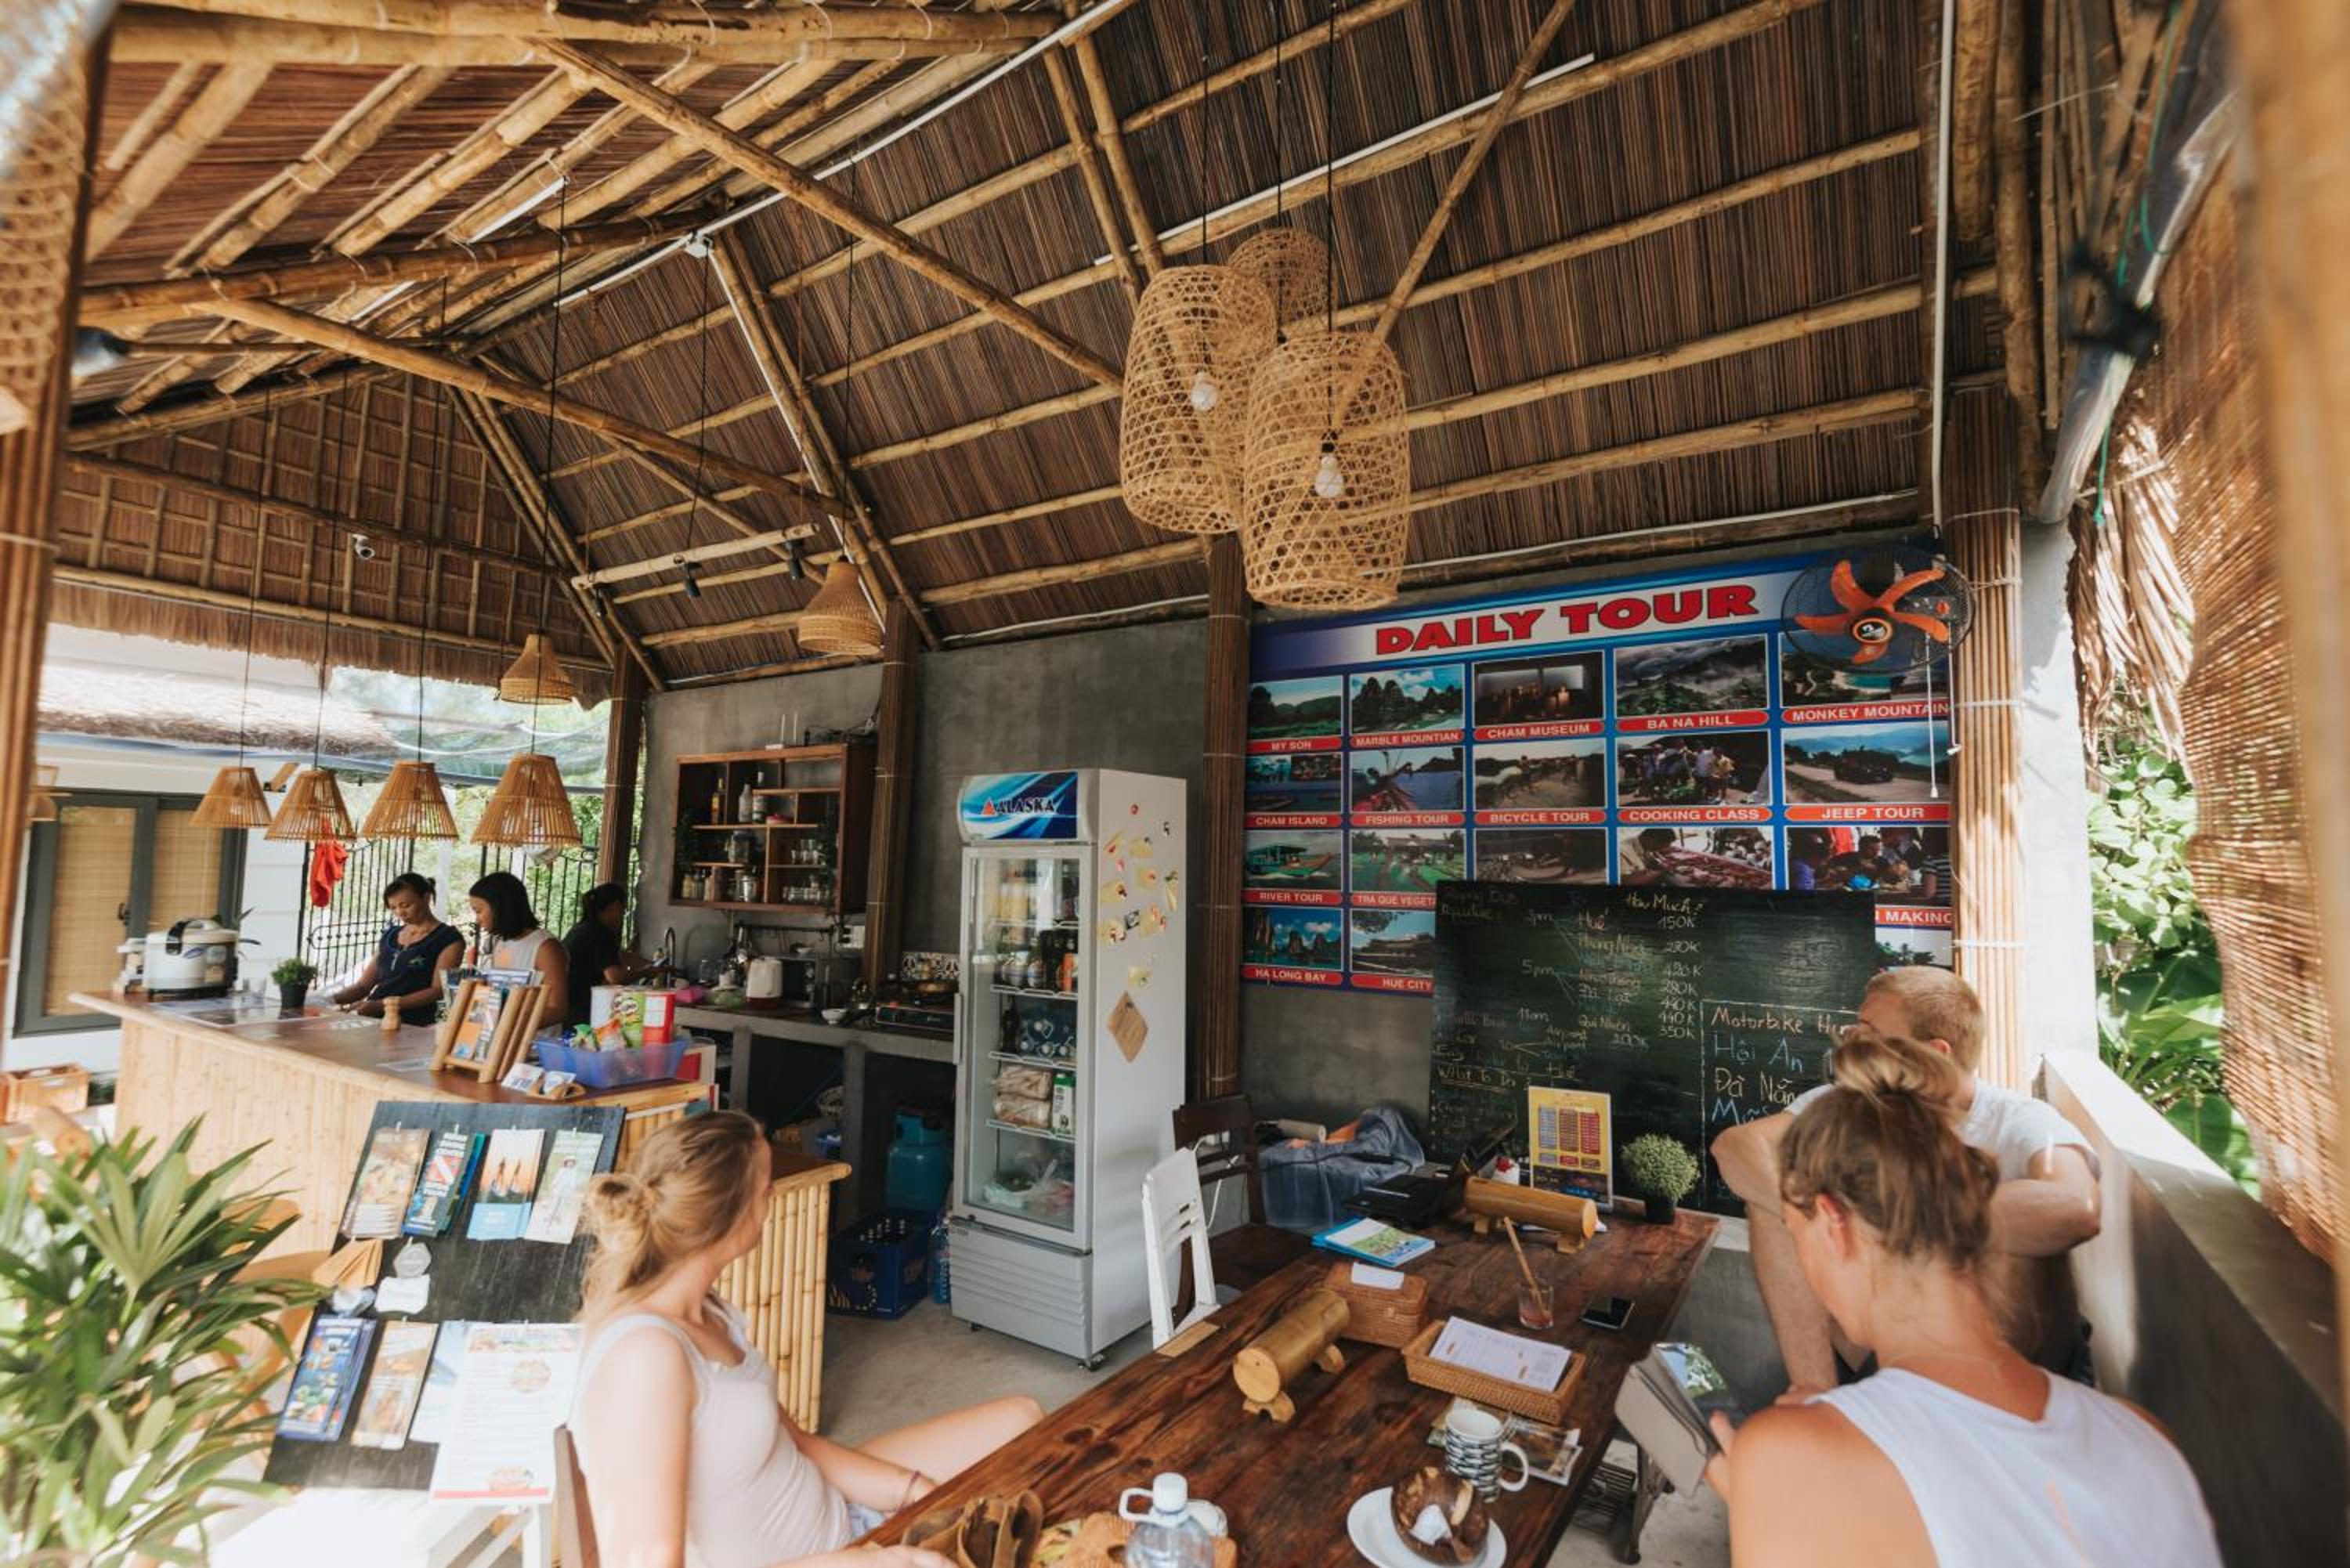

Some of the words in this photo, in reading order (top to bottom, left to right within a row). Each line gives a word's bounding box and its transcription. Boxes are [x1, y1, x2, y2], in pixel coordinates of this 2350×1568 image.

[1376, 609, 1545, 655] DAILY
[1560, 584, 1759, 634] TOUR
[1792, 707, 1859, 721] MONKEY
[1864, 702, 1949, 717] MOUNTAIN
[1647, 717, 1668, 729] BA
[1672, 716, 1694, 728] NA
[1698, 714, 1735, 727] HILL
[1488, 727, 1526, 739] CHAM
[1530, 724, 1590, 737] MUSEUM
[1289, 741, 1312, 750] SON
[1356, 736, 1400, 747] MARBLE
[996, 797, 1054, 815] ALASKA
[1490, 812, 1547, 823] BICYCLE
[1552, 811, 1590, 822] TOUR
[1629, 810, 1701, 822] COOKING
[1705, 808, 1760, 821] CLASS
[1821, 807, 1867, 819] JEEP
[1873, 807, 1925, 819] TOUR
[1256, 816, 1285, 826] CHAM
[1289, 816, 1329, 826] ISLAND
[1365, 815, 1412, 825] FISHING
[1415, 815, 1449, 824] TOUR
[1259, 891, 1291, 901] RIVER
[1292, 893, 1323, 902] TOUR
[1358, 894, 1376, 904] TRA
[1378, 895, 1398, 905] QUE
[1255, 969, 1270, 977] HA
[1272, 970, 1302, 980] LONG
[1304, 972, 1327, 981] BAY
[1383, 978, 1405, 988] HUE
[1408, 979, 1432, 990] CITY
